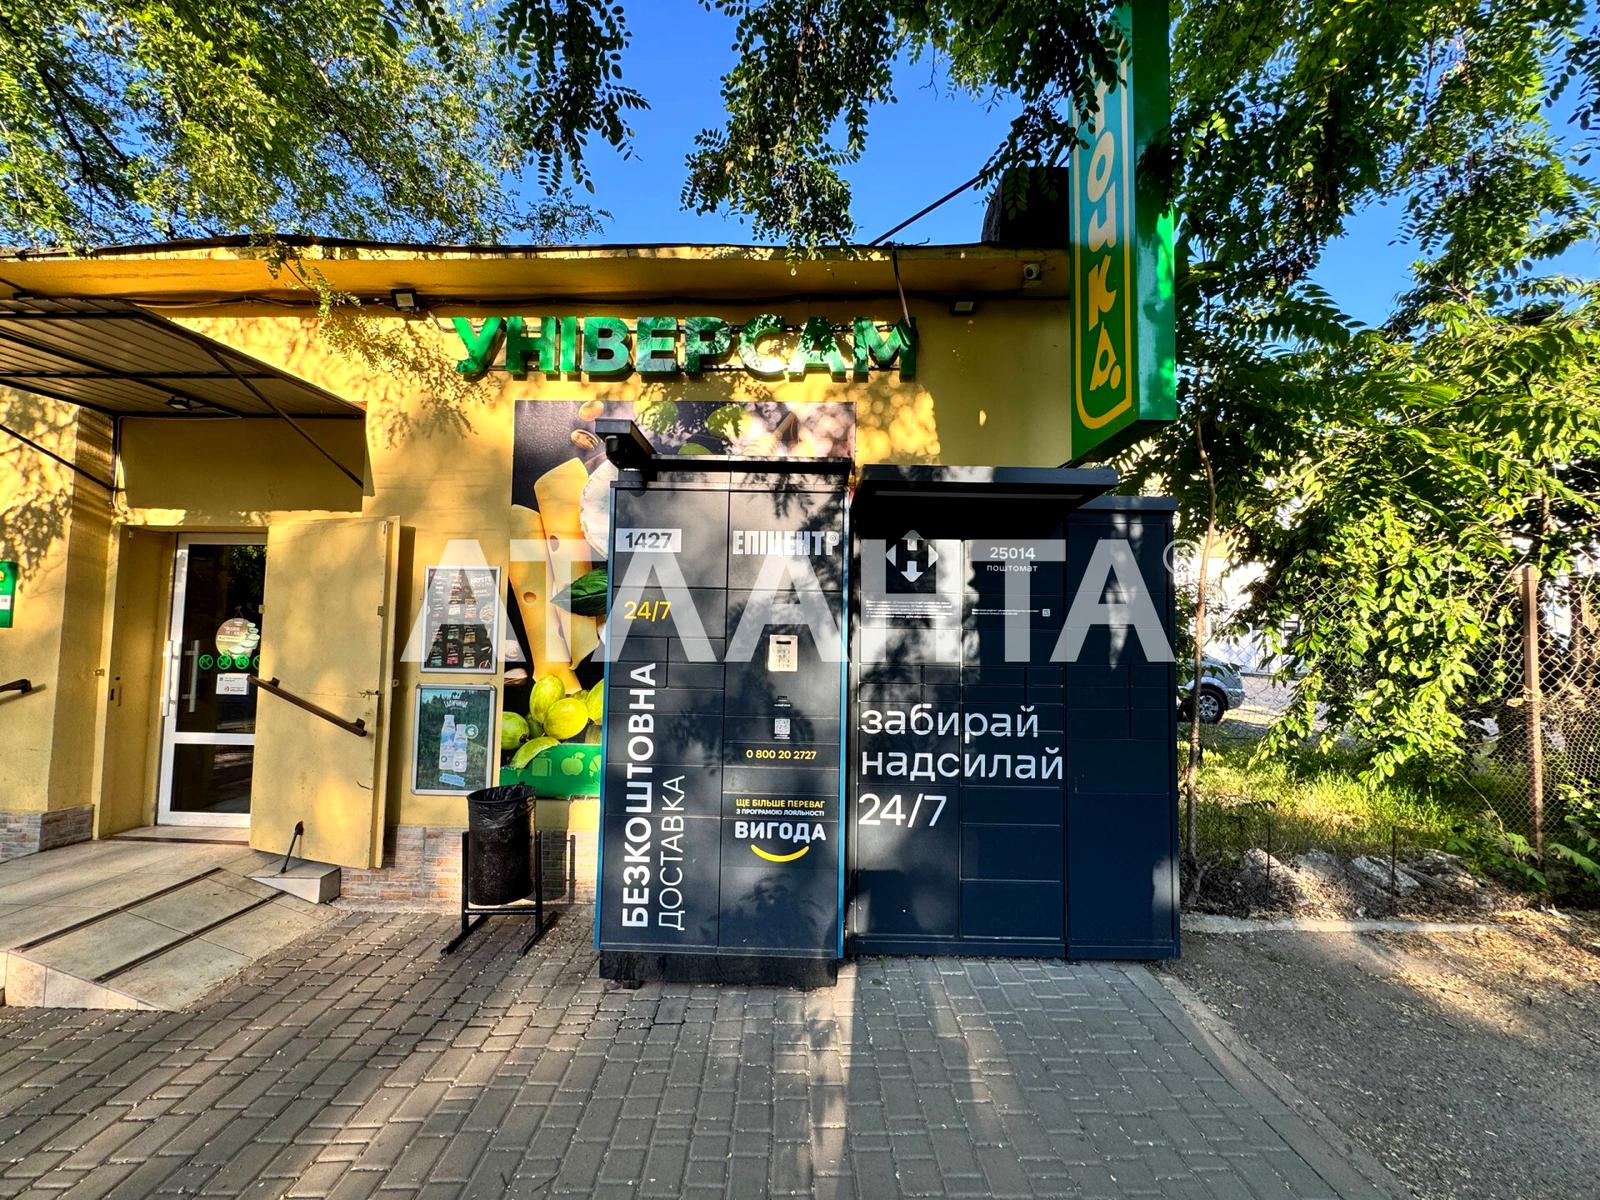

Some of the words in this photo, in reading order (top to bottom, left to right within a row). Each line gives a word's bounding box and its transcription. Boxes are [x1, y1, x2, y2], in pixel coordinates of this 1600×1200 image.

[451, 314, 918, 380] УНІВЕРСАМ
[625, 532, 672, 549] 1427
[732, 530, 840, 557] ЕПІЦЕНТР
[990, 546, 1036, 560] 25014
[986, 565, 1038, 573] поштомат
[623, 600, 672, 622] 24/7
[860, 703, 1039, 744] забирай
[746, 750, 753, 758] 0
[755, 750, 776, 759] 800
[778, 750, 792, 759] 20
[793, 751, 817, 760] 2727
[861, 746, 1063, 782] надсилай
[622, 662, 656, 927] БЕЗКОШТОВНА
[736, 799, 750, 808] ЩЕ
[752, 799, 786, 808] БІЛЬШЕ
[787, 800, 826, 809] ПЕРЕВАГ
[783, 809, 825, 817] ЛОЯЛЬНОСТІ
[858, 793, 947, 828] 24/7
[734, 821, 827, 844] ВИГОДА
[658, 775, 686, 931] ДОСТАВКА
